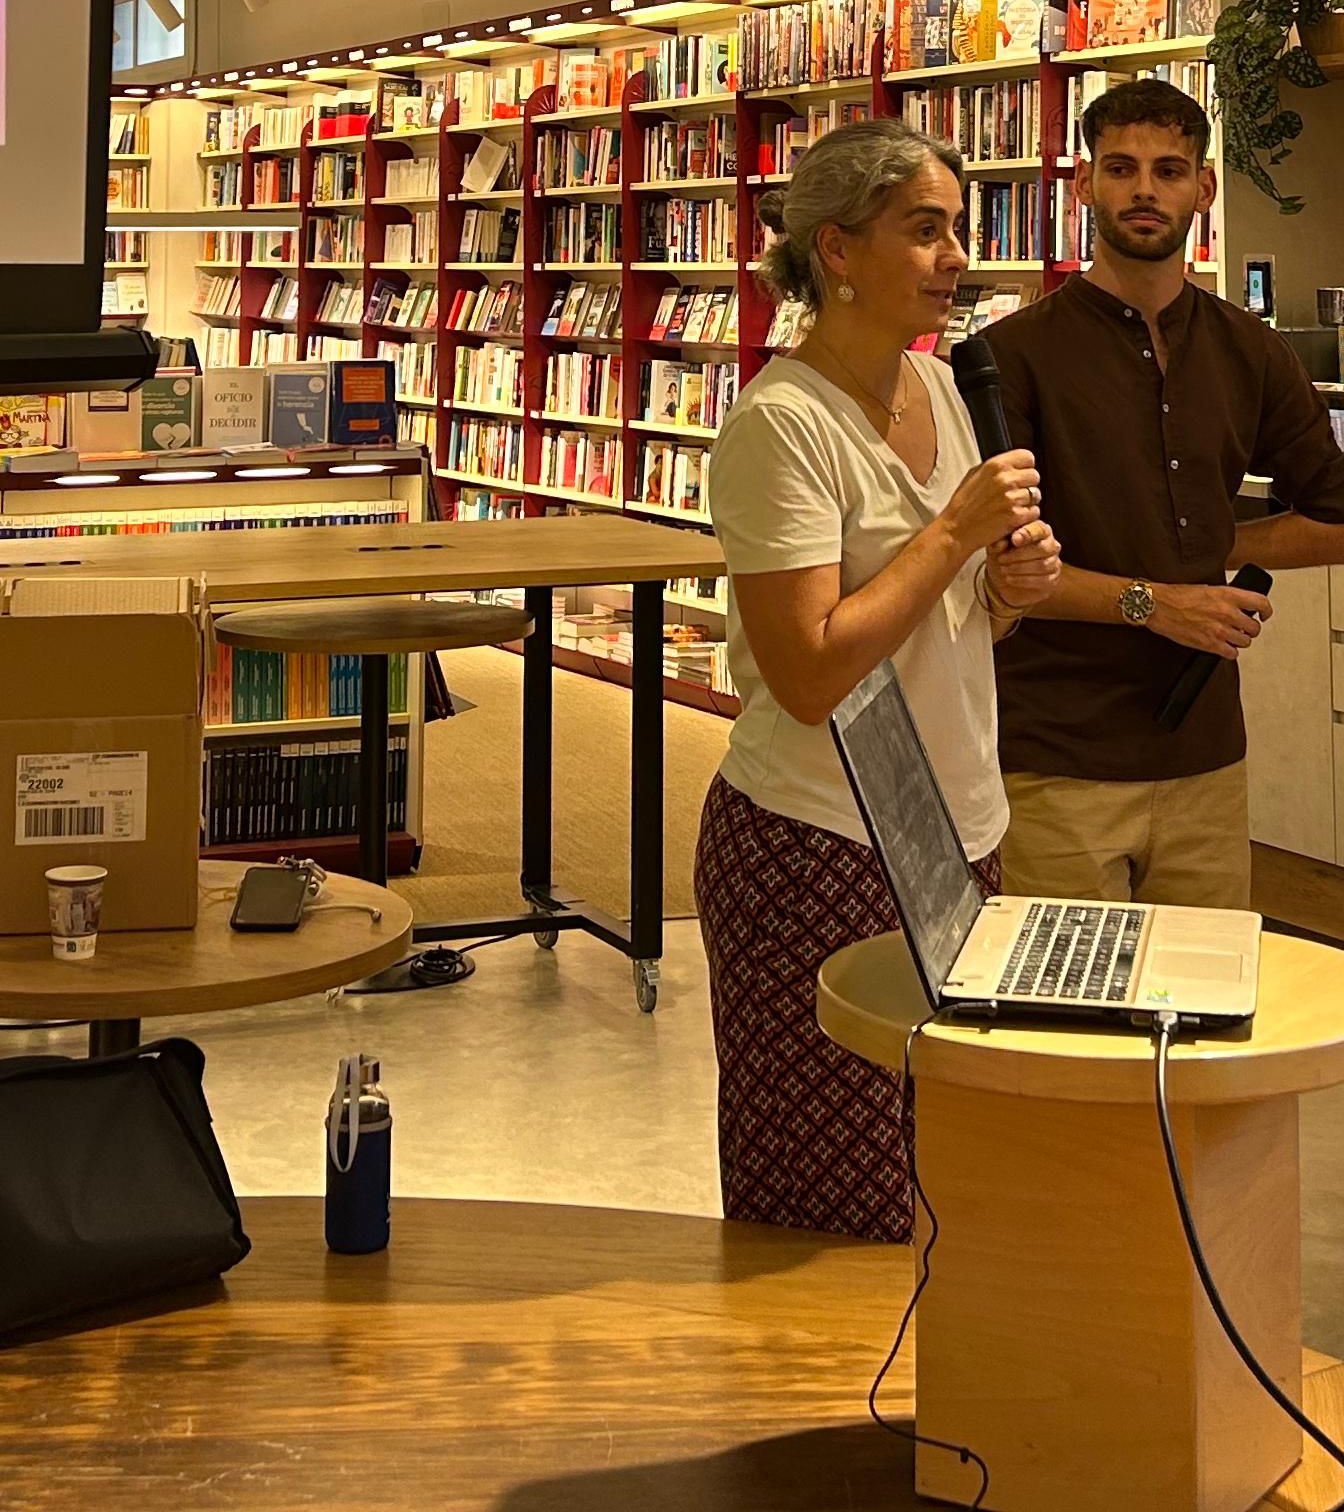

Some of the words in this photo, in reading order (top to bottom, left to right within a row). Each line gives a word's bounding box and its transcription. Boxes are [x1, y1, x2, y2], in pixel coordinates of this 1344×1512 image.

[214, 392, 253, 402] OFICIO
[209, 416, 257, 428] DECIDIR
[28, 778, 64, 789] 22002
